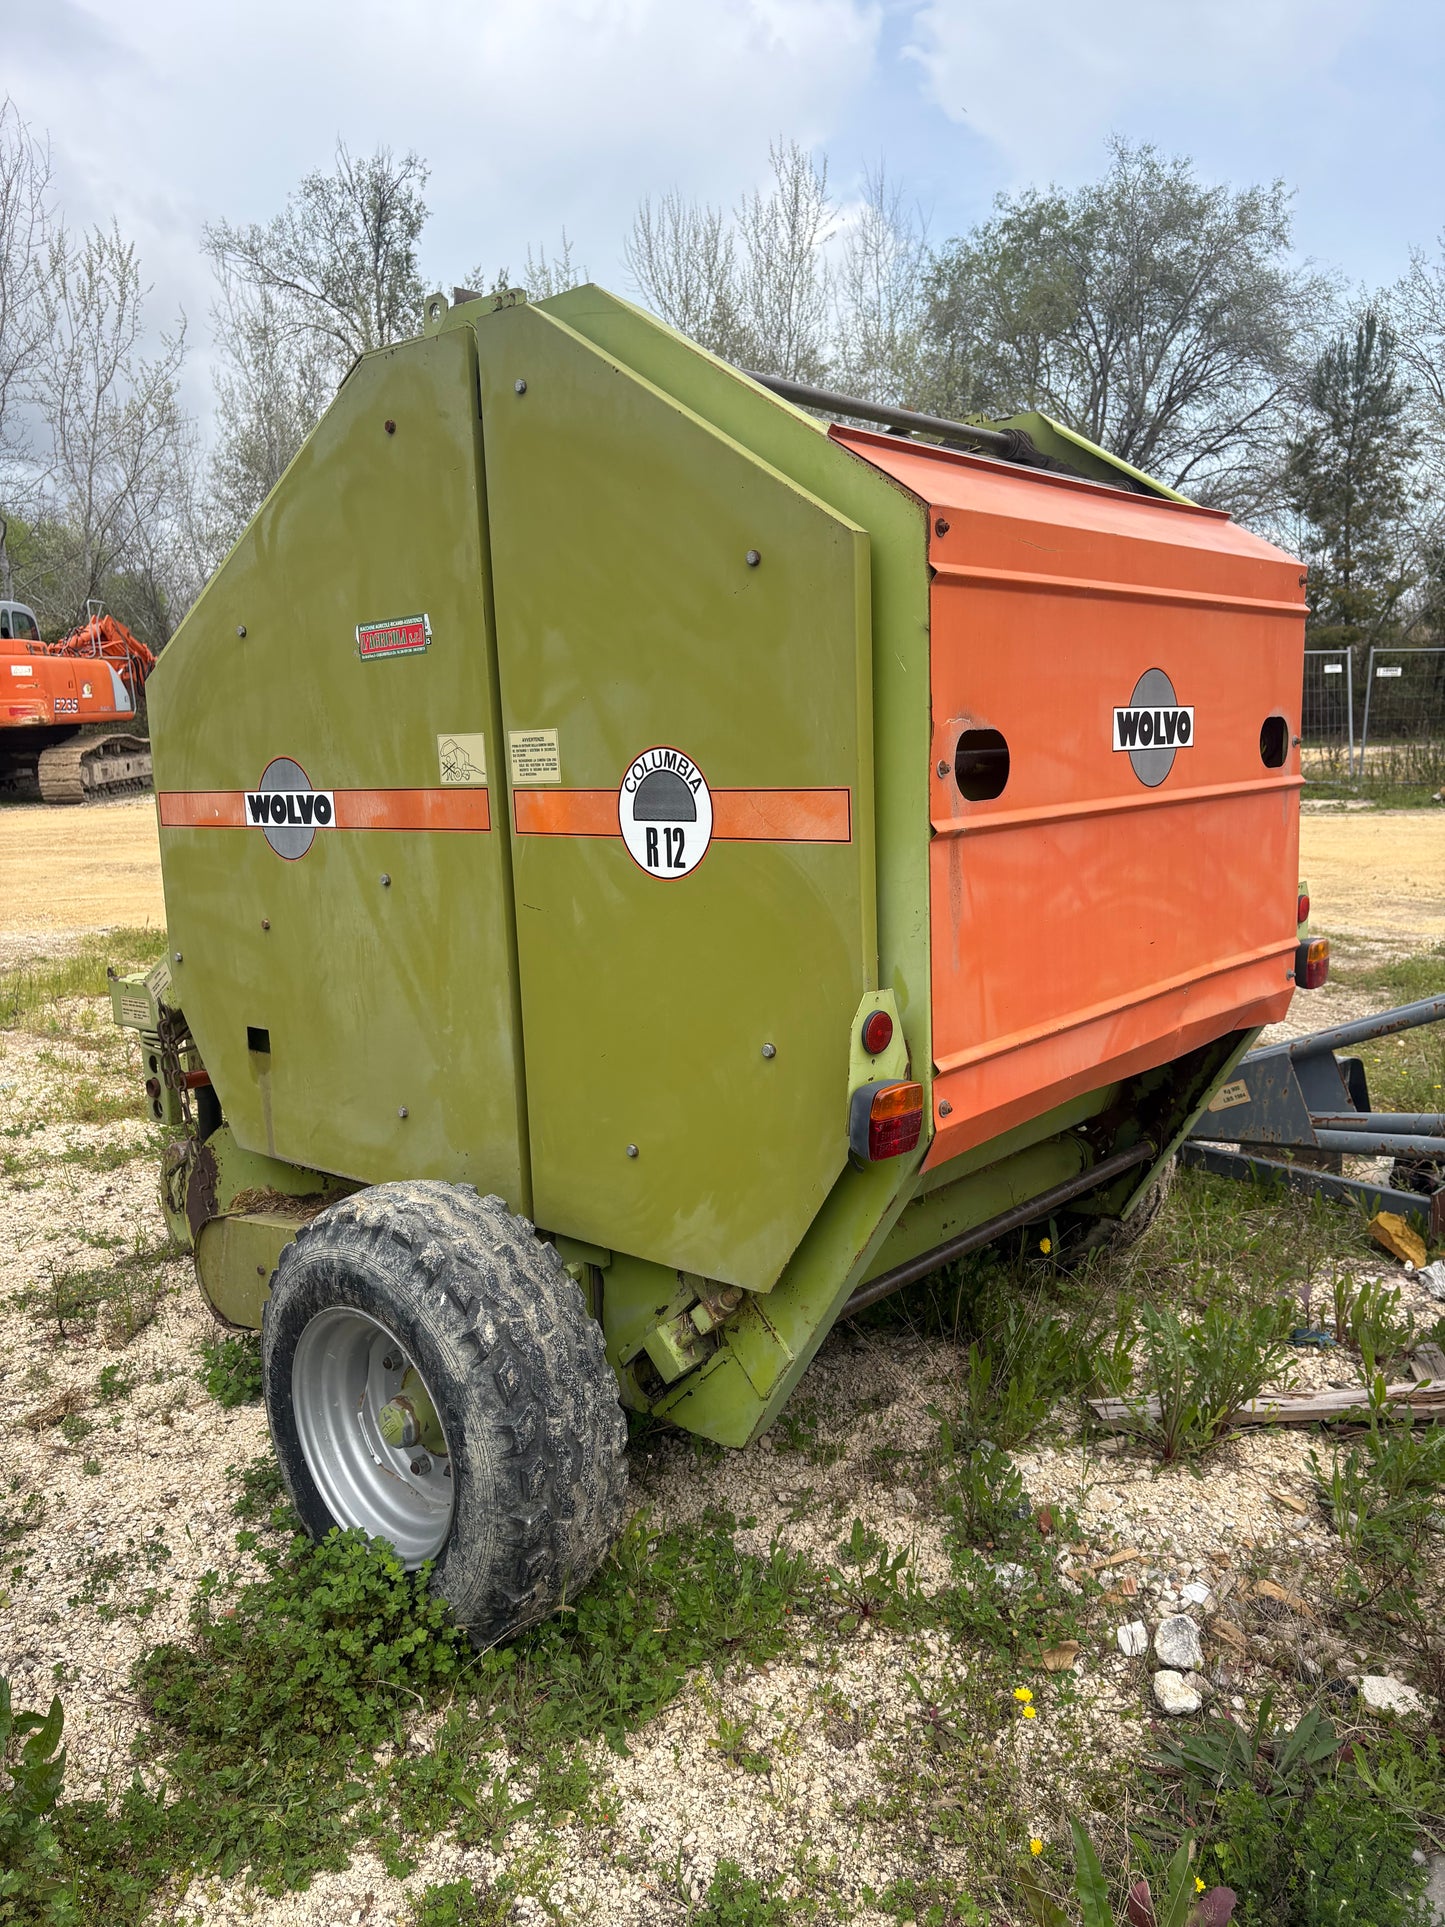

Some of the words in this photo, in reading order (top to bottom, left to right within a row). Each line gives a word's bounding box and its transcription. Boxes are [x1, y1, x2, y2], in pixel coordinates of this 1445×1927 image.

[54, 698, 79, 713] E235
[1116, 710, 1191, 747] WOLVO
[624, 750, 703, 795] COLUMBIA
[247, 794, 332, 825] WOLVO
